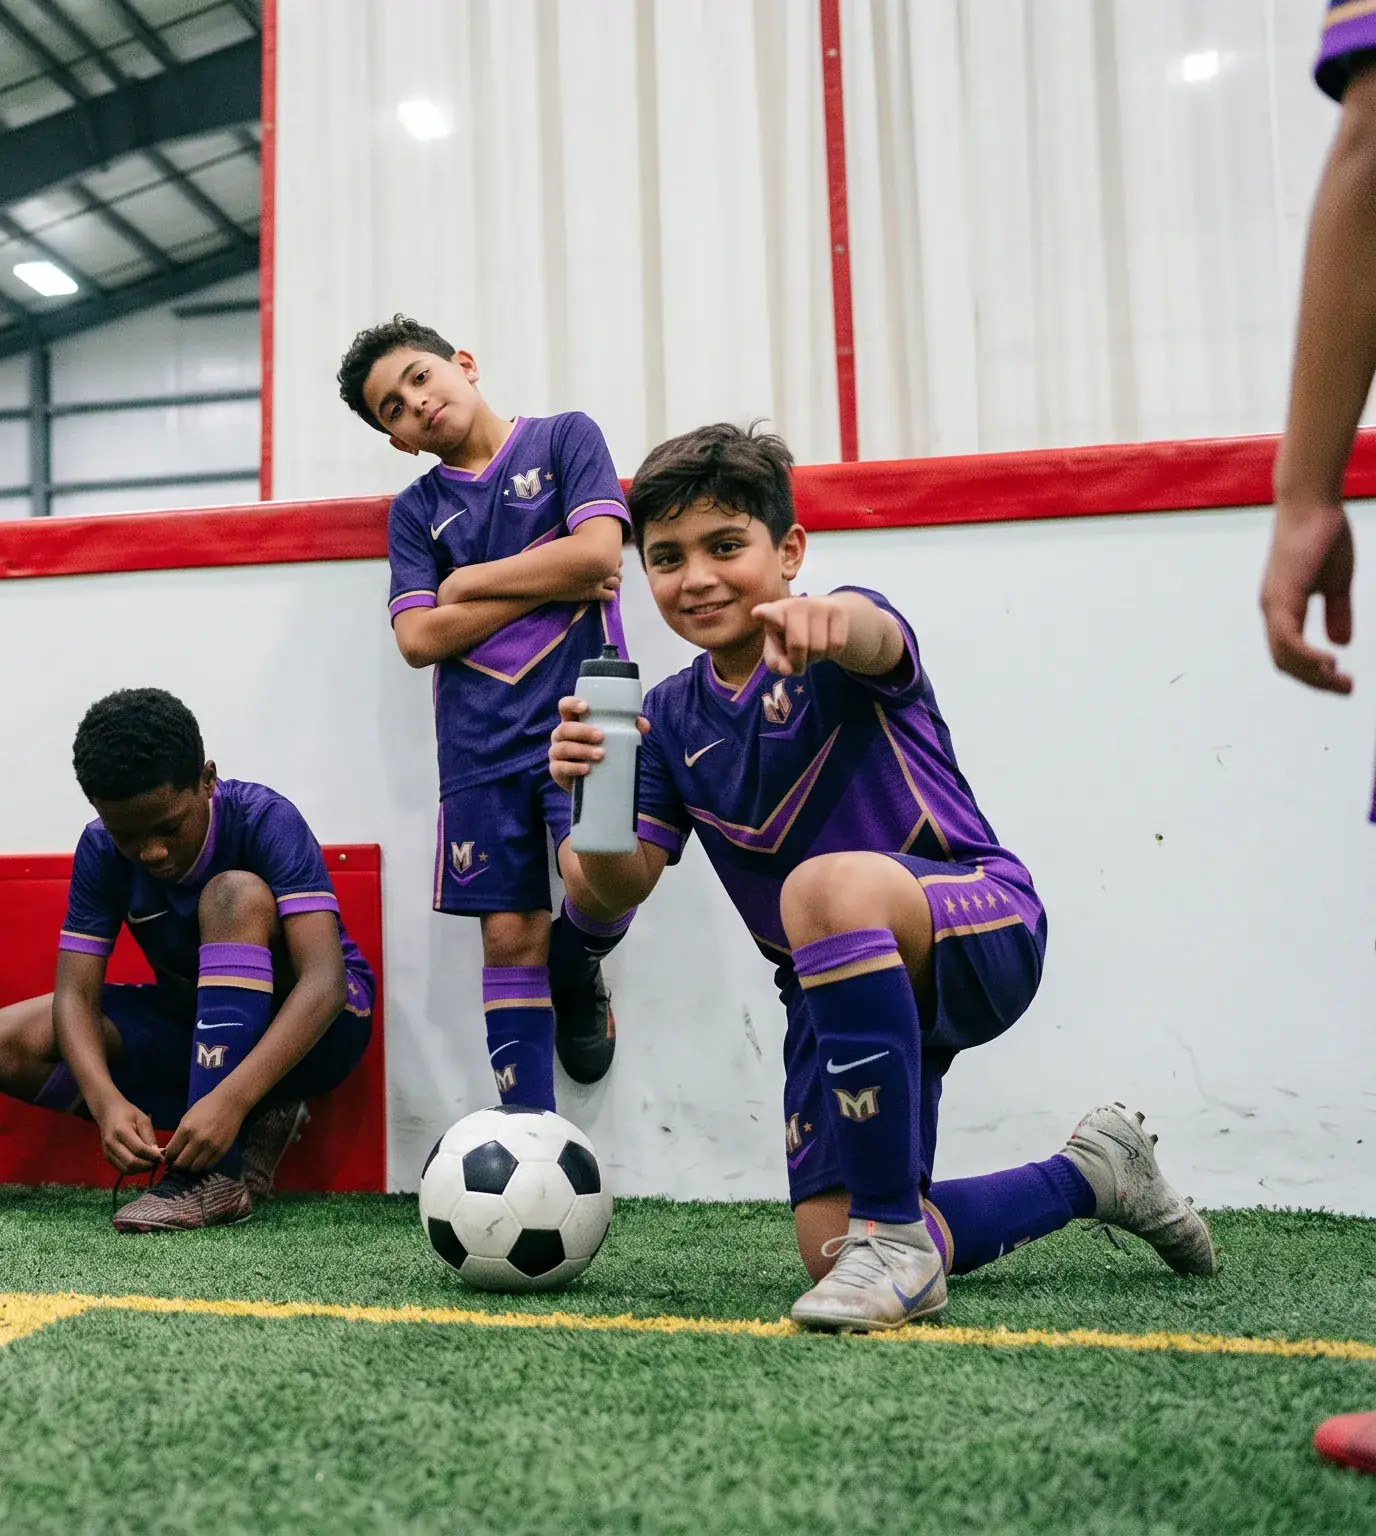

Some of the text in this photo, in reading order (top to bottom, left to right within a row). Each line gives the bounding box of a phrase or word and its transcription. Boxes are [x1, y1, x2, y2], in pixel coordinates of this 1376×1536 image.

[510, 467, 541, 499] M
[761, 678, 792, 723] M
[450, 841, 475, 873] M
[196, 1041, 229, 1069] M
[494, 1063, 517, 1092] M
[832, 1086, 881, 1122] M
